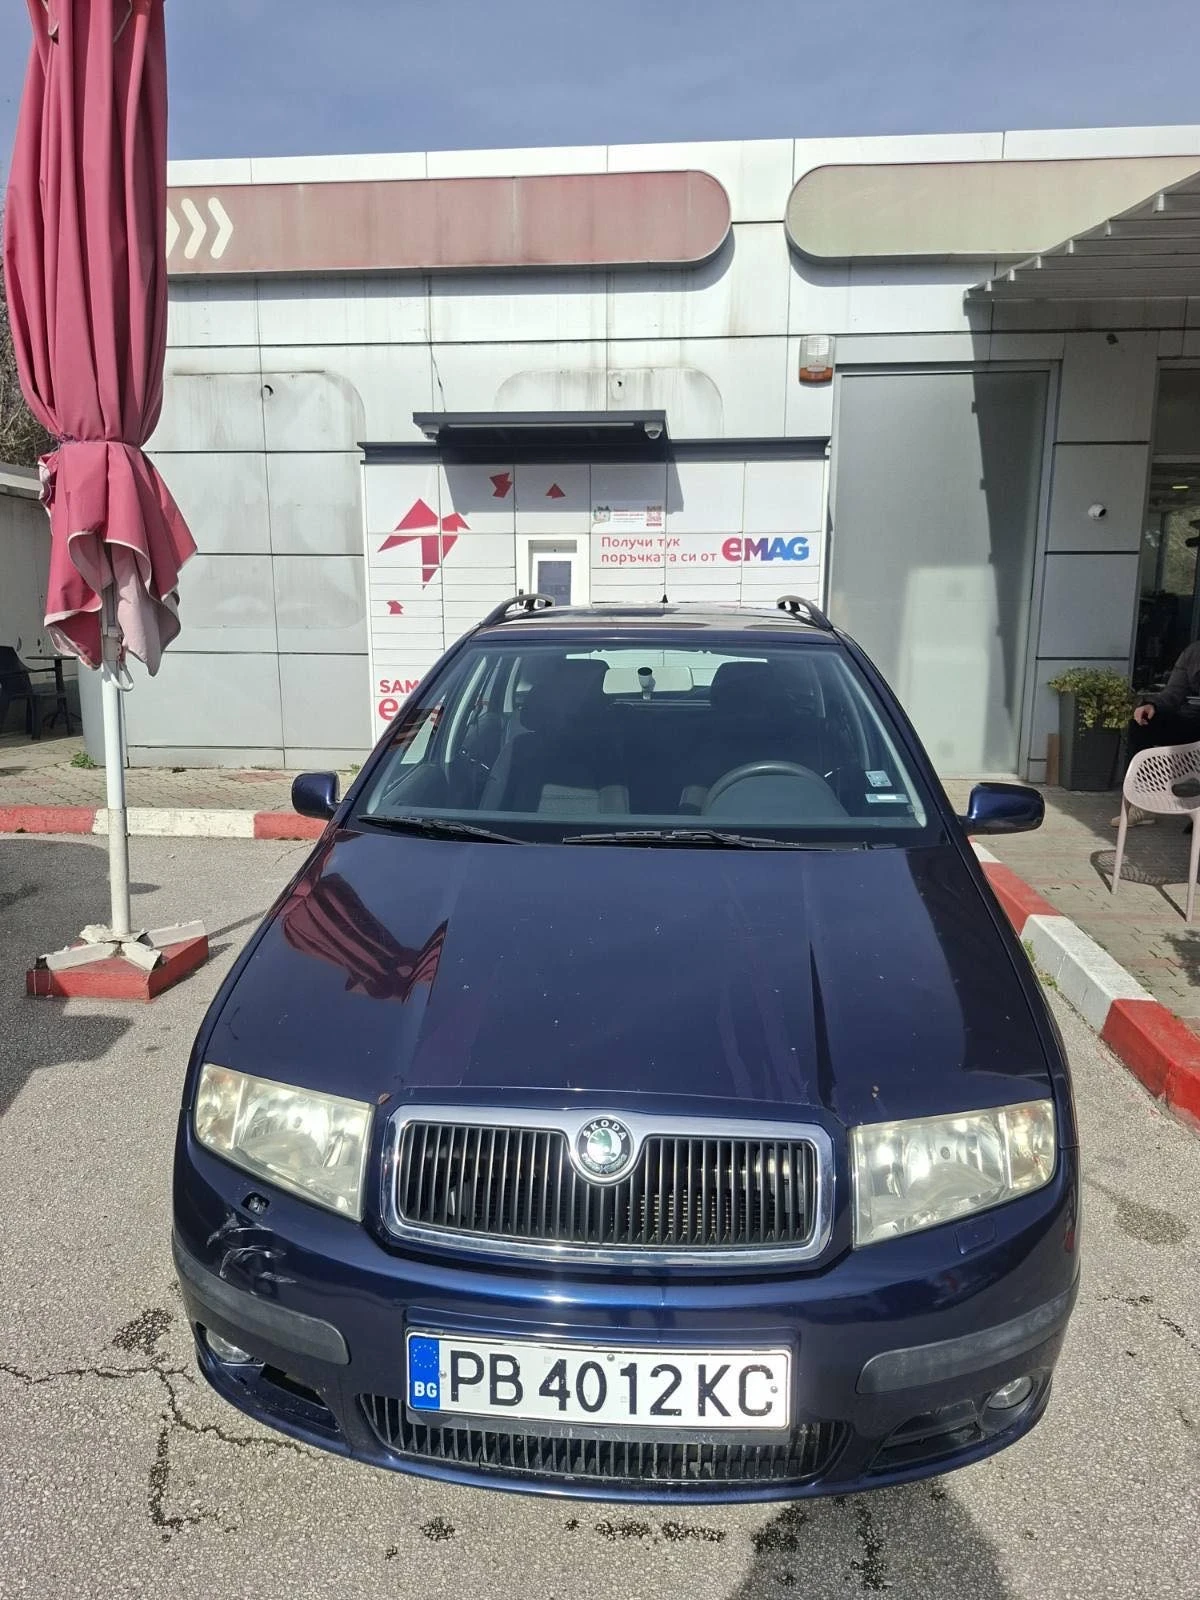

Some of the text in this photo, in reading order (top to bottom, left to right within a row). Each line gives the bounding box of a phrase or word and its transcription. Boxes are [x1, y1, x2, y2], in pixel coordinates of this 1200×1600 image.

[601, 536, 681, 550] Получи тук
[722, 536, 810, 562] eMAG
[601, 552, 718, 566] поръчката си от
[414, 1380, 438, 1398] BG
[450, 1349, 774, 1417] PB 4012 KC
